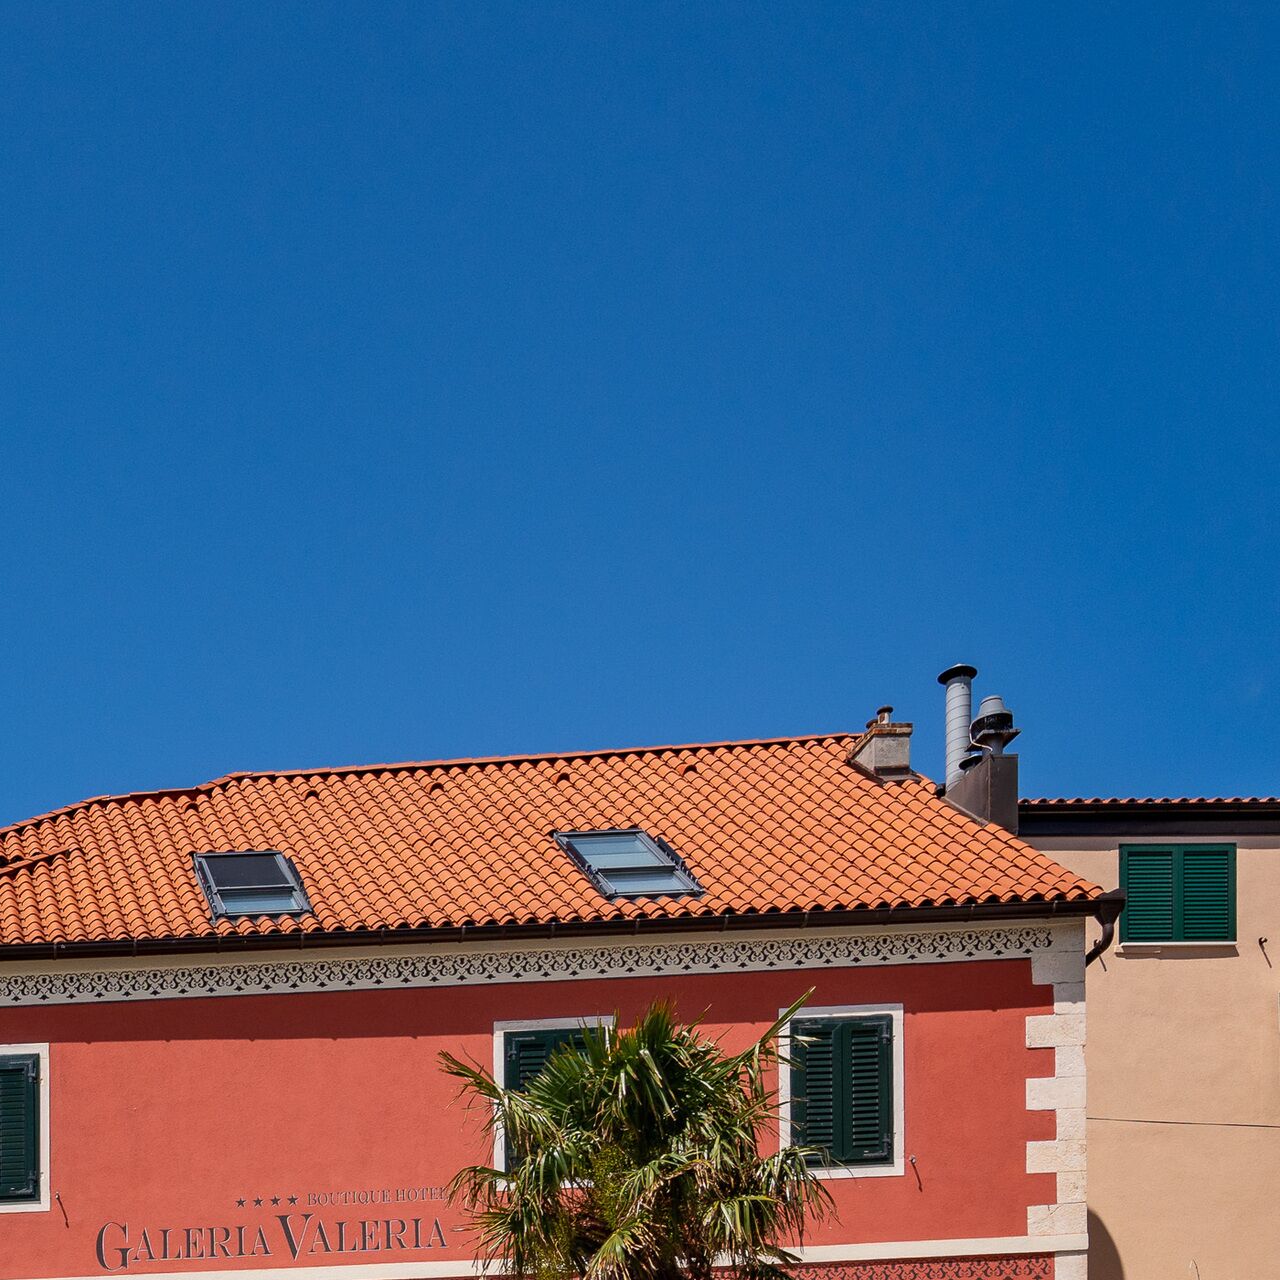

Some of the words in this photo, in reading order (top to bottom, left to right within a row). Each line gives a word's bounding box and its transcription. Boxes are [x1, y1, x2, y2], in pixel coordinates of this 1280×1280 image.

[307, 1189, 391, 1206] BOUTIQUE
[395, 1186, 449, 1202] HOTEL
[95, 1221, 273, 1272] GALERIA
[276, 1212, 449, 1262] VALERIA
